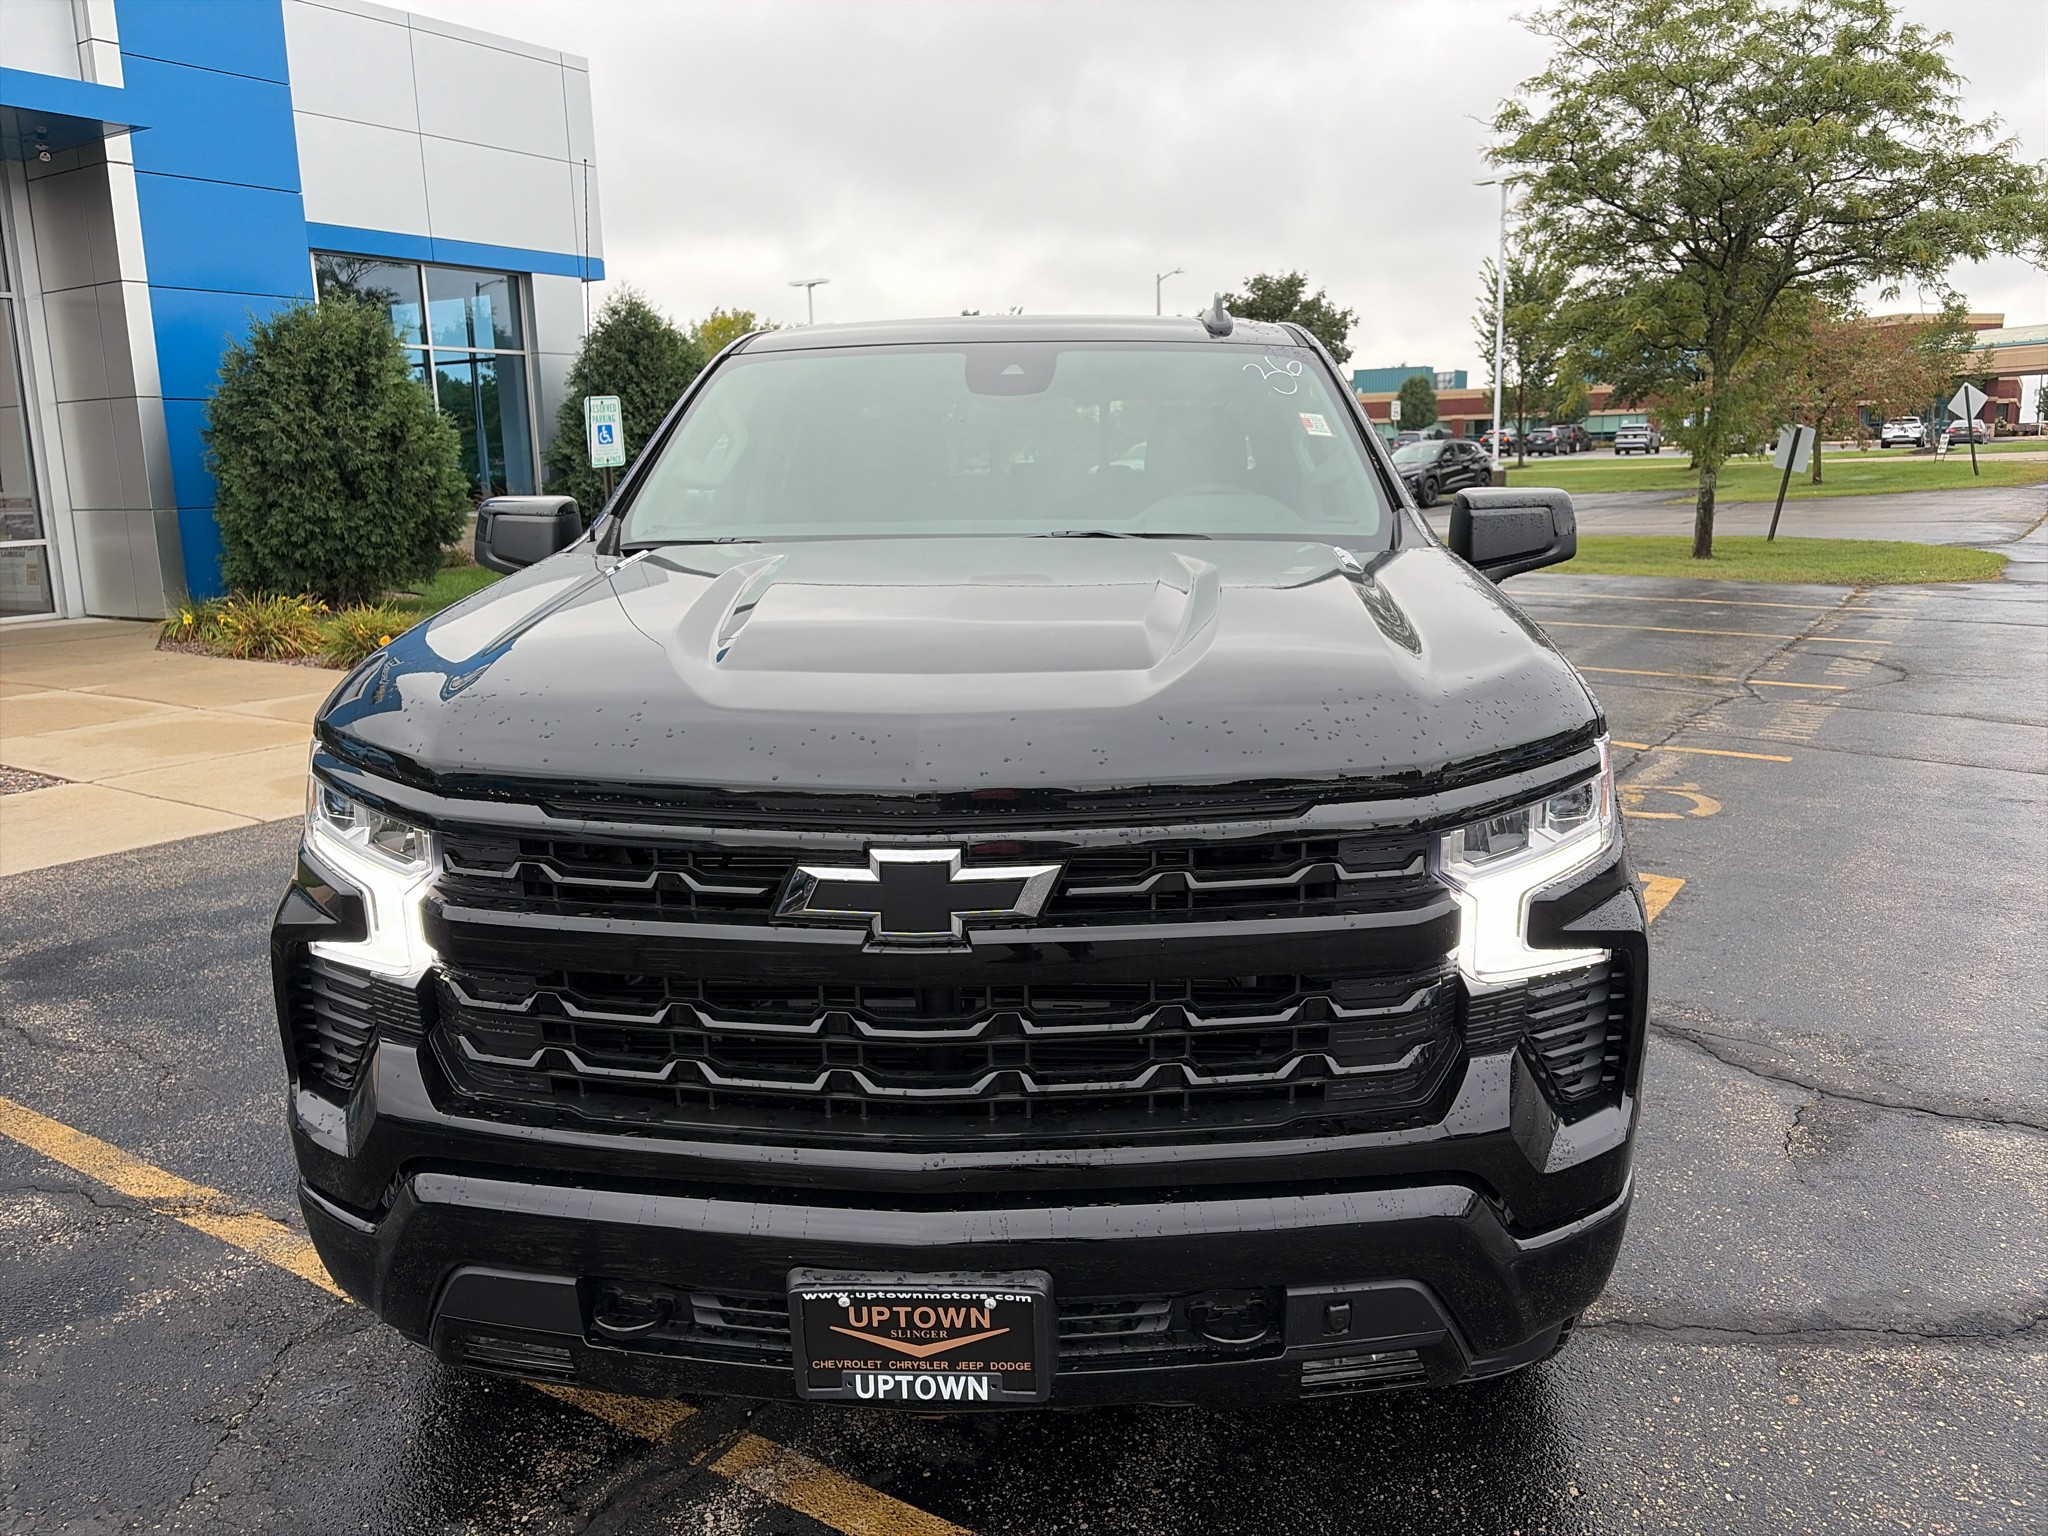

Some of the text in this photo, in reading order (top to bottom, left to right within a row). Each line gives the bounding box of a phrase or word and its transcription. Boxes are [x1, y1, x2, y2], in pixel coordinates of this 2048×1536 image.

[590, 403, 617, 413] ESERVED
[591, 414, 616, 424] PARKING
[802, 1291, 1032, 1303] www.uptownmotors.com
[848, 1306, 991, 1329] UPTOWN
[890, 1329, 948, 1339] SLINGER
[812, 1360, 1032, 1371] CHEVROLET CHRYSLER JEEP DODGE
[855, 1374, 988, 1401] UPTOWN
